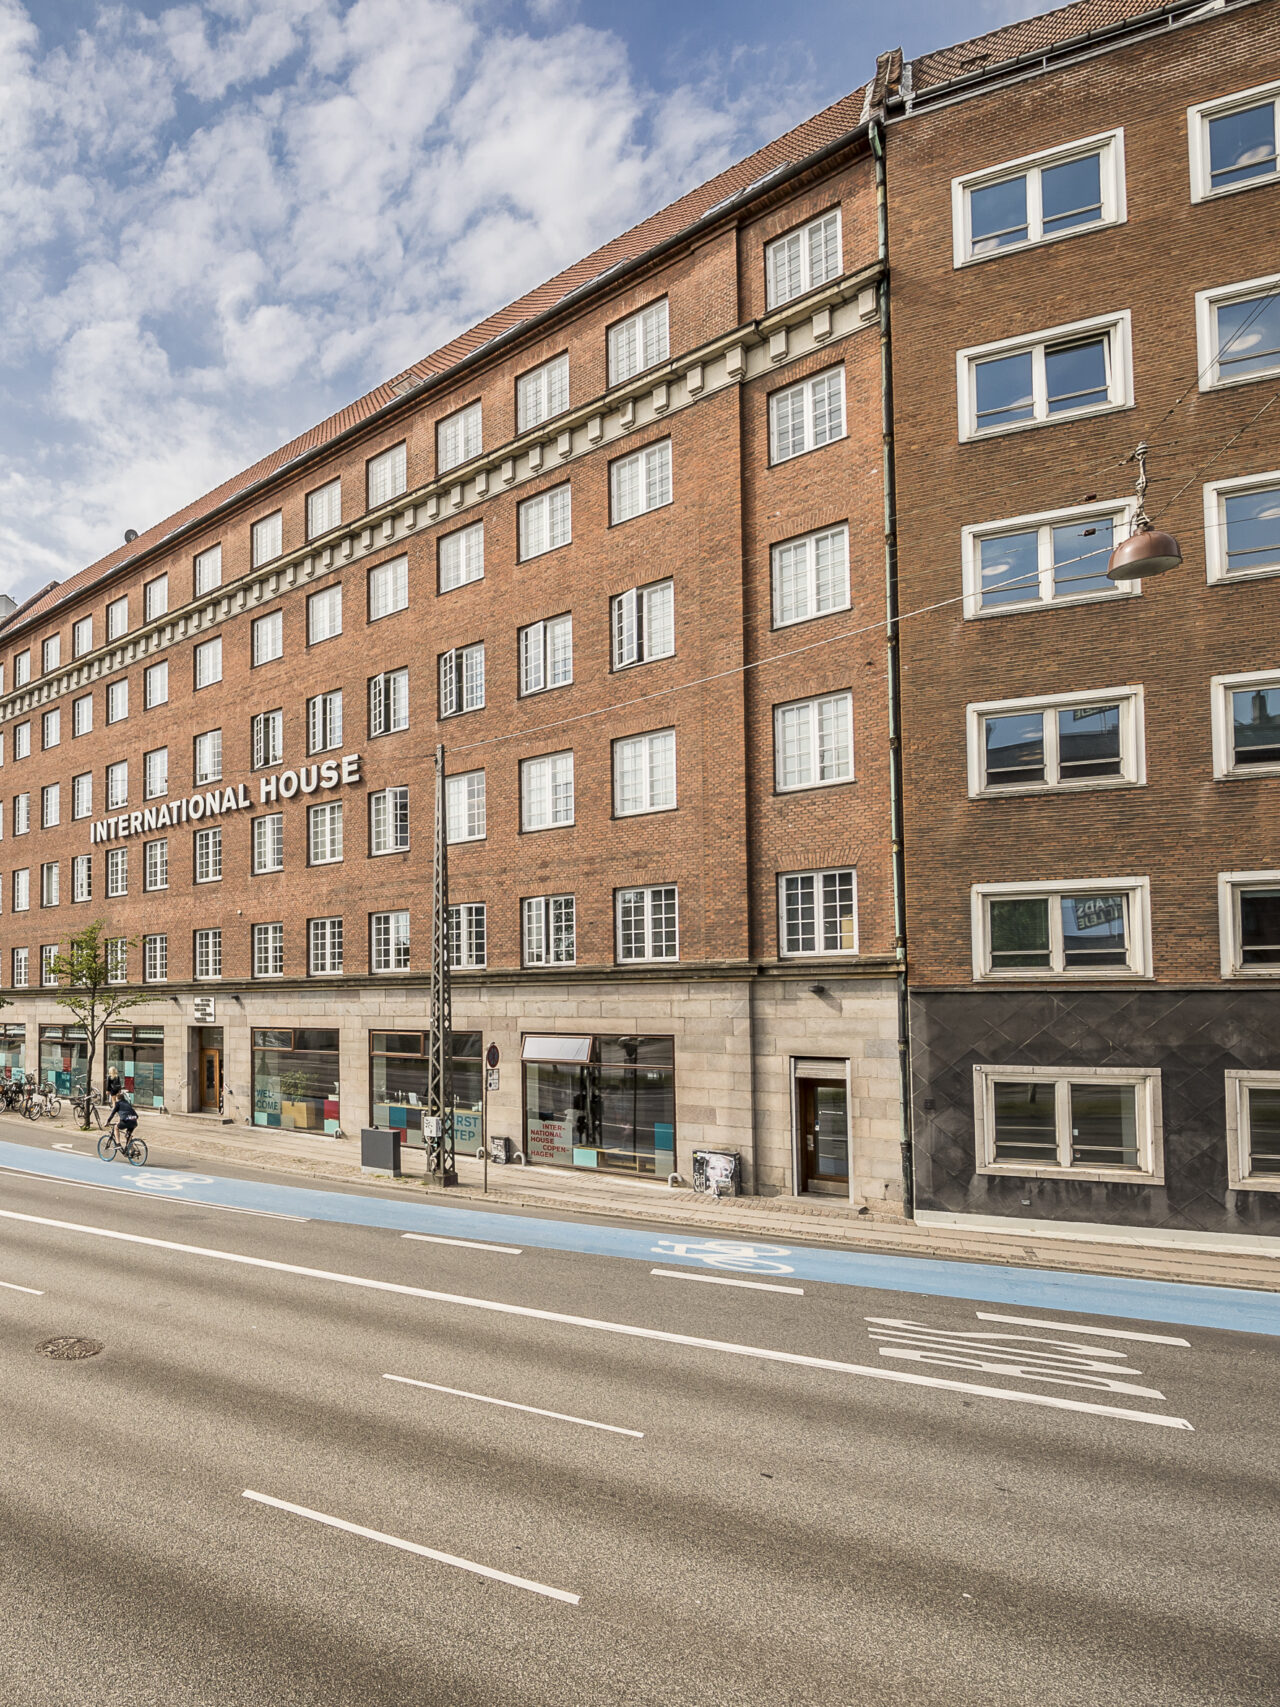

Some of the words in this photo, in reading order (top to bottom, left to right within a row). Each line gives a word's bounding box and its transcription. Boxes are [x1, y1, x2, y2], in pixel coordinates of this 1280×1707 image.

[90, 783, 250, 844] INTERNATIONAL
[260, 753, 362, 803] HOUSE
[256, 1089, 274, 1101] WEL-
[256, 1100, 278, 1110] COME
[446, 1115, 480, 1128] RST
[542, 1123, 566, 1131] INTER-
[530, 1129, 563, 1138] NATIONAL
[542, 1144, 570, 1153] COPEN-
[530, 1150, 554, 1158] HAGEN
